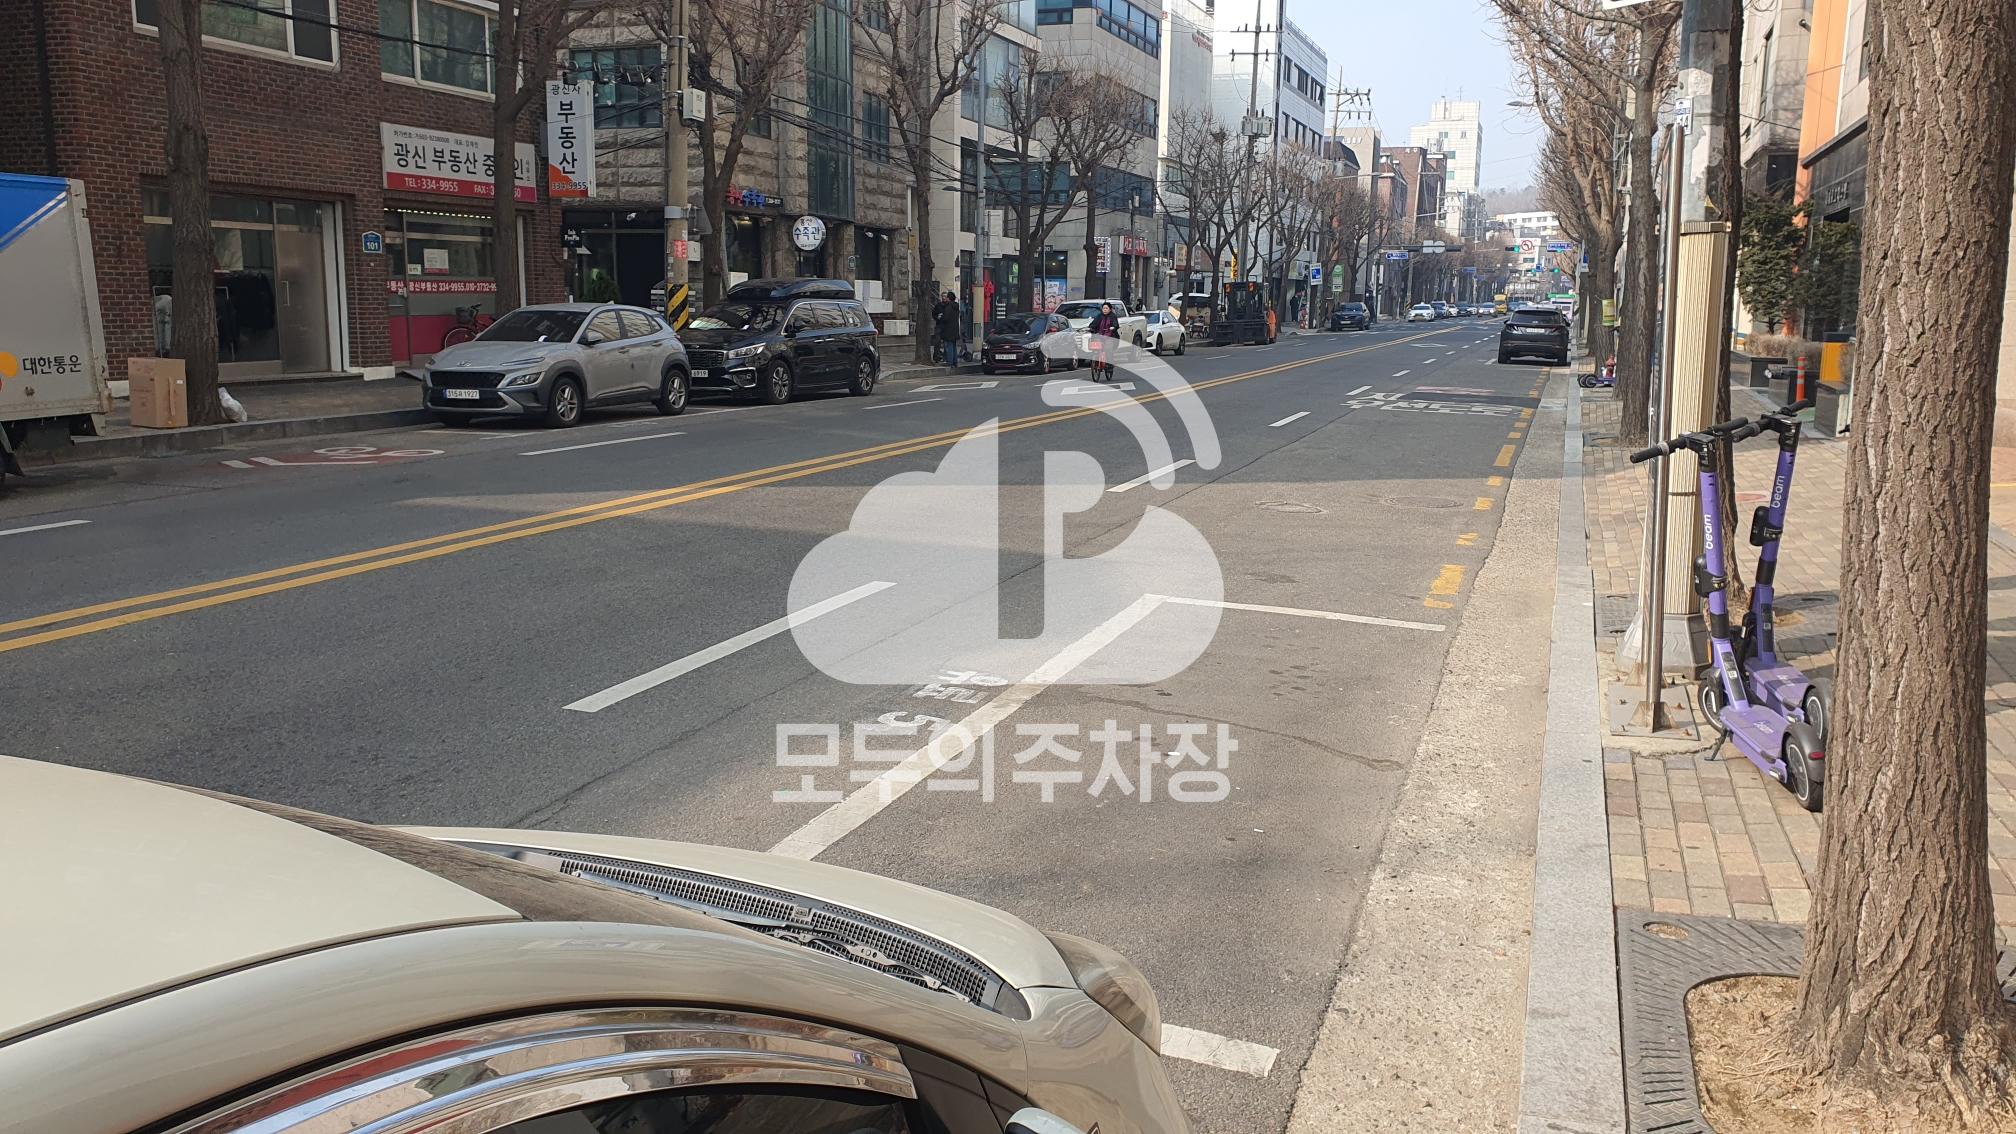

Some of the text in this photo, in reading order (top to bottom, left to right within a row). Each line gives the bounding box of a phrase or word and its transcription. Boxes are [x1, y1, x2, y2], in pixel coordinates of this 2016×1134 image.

[551, 83, 581, 95] 광신사
[557, 100, 578, 175] 부동산
[393, 142, 524, 181] 광신 부동산 중인
[551, 181, 587, 191] 334-9955
[794, 226, 820, 241] 수족관
[366, 241, 379, 250] 101
[22, 354, 82, 375] 대한통운
[1771, 475, 1785, 508] beam
[1704, 514, 1714, 550] beam
